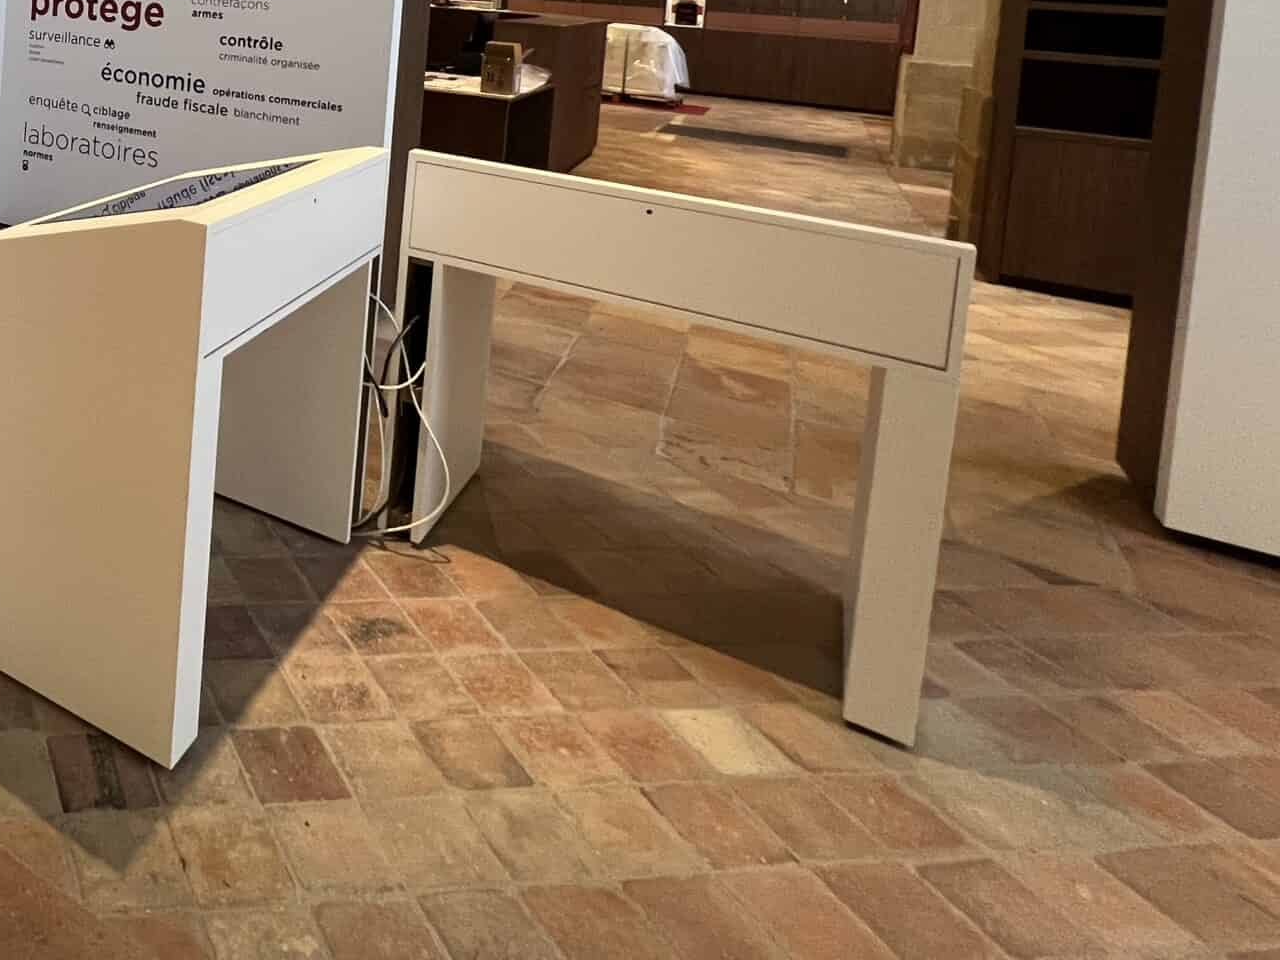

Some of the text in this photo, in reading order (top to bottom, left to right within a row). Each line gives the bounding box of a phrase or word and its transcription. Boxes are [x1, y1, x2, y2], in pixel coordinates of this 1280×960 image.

[192, 10, 224, 20] armes
[28, 28, 101, 48] surveillance
[220, 34, 284, 52] contrôle
[219, 52, 320, 71] criminalité organisée
[100, 62, 343, 112] économie opérations commerciales
[28, 94, 130, 120] enquête ciblage
[136, 92, 300, 126] fraude fiscale blanchiment
[92, 120, 157, 138] renseignement
[22, 122, 159, 168] laboratoires
[22, 150, 53, 161] normes
